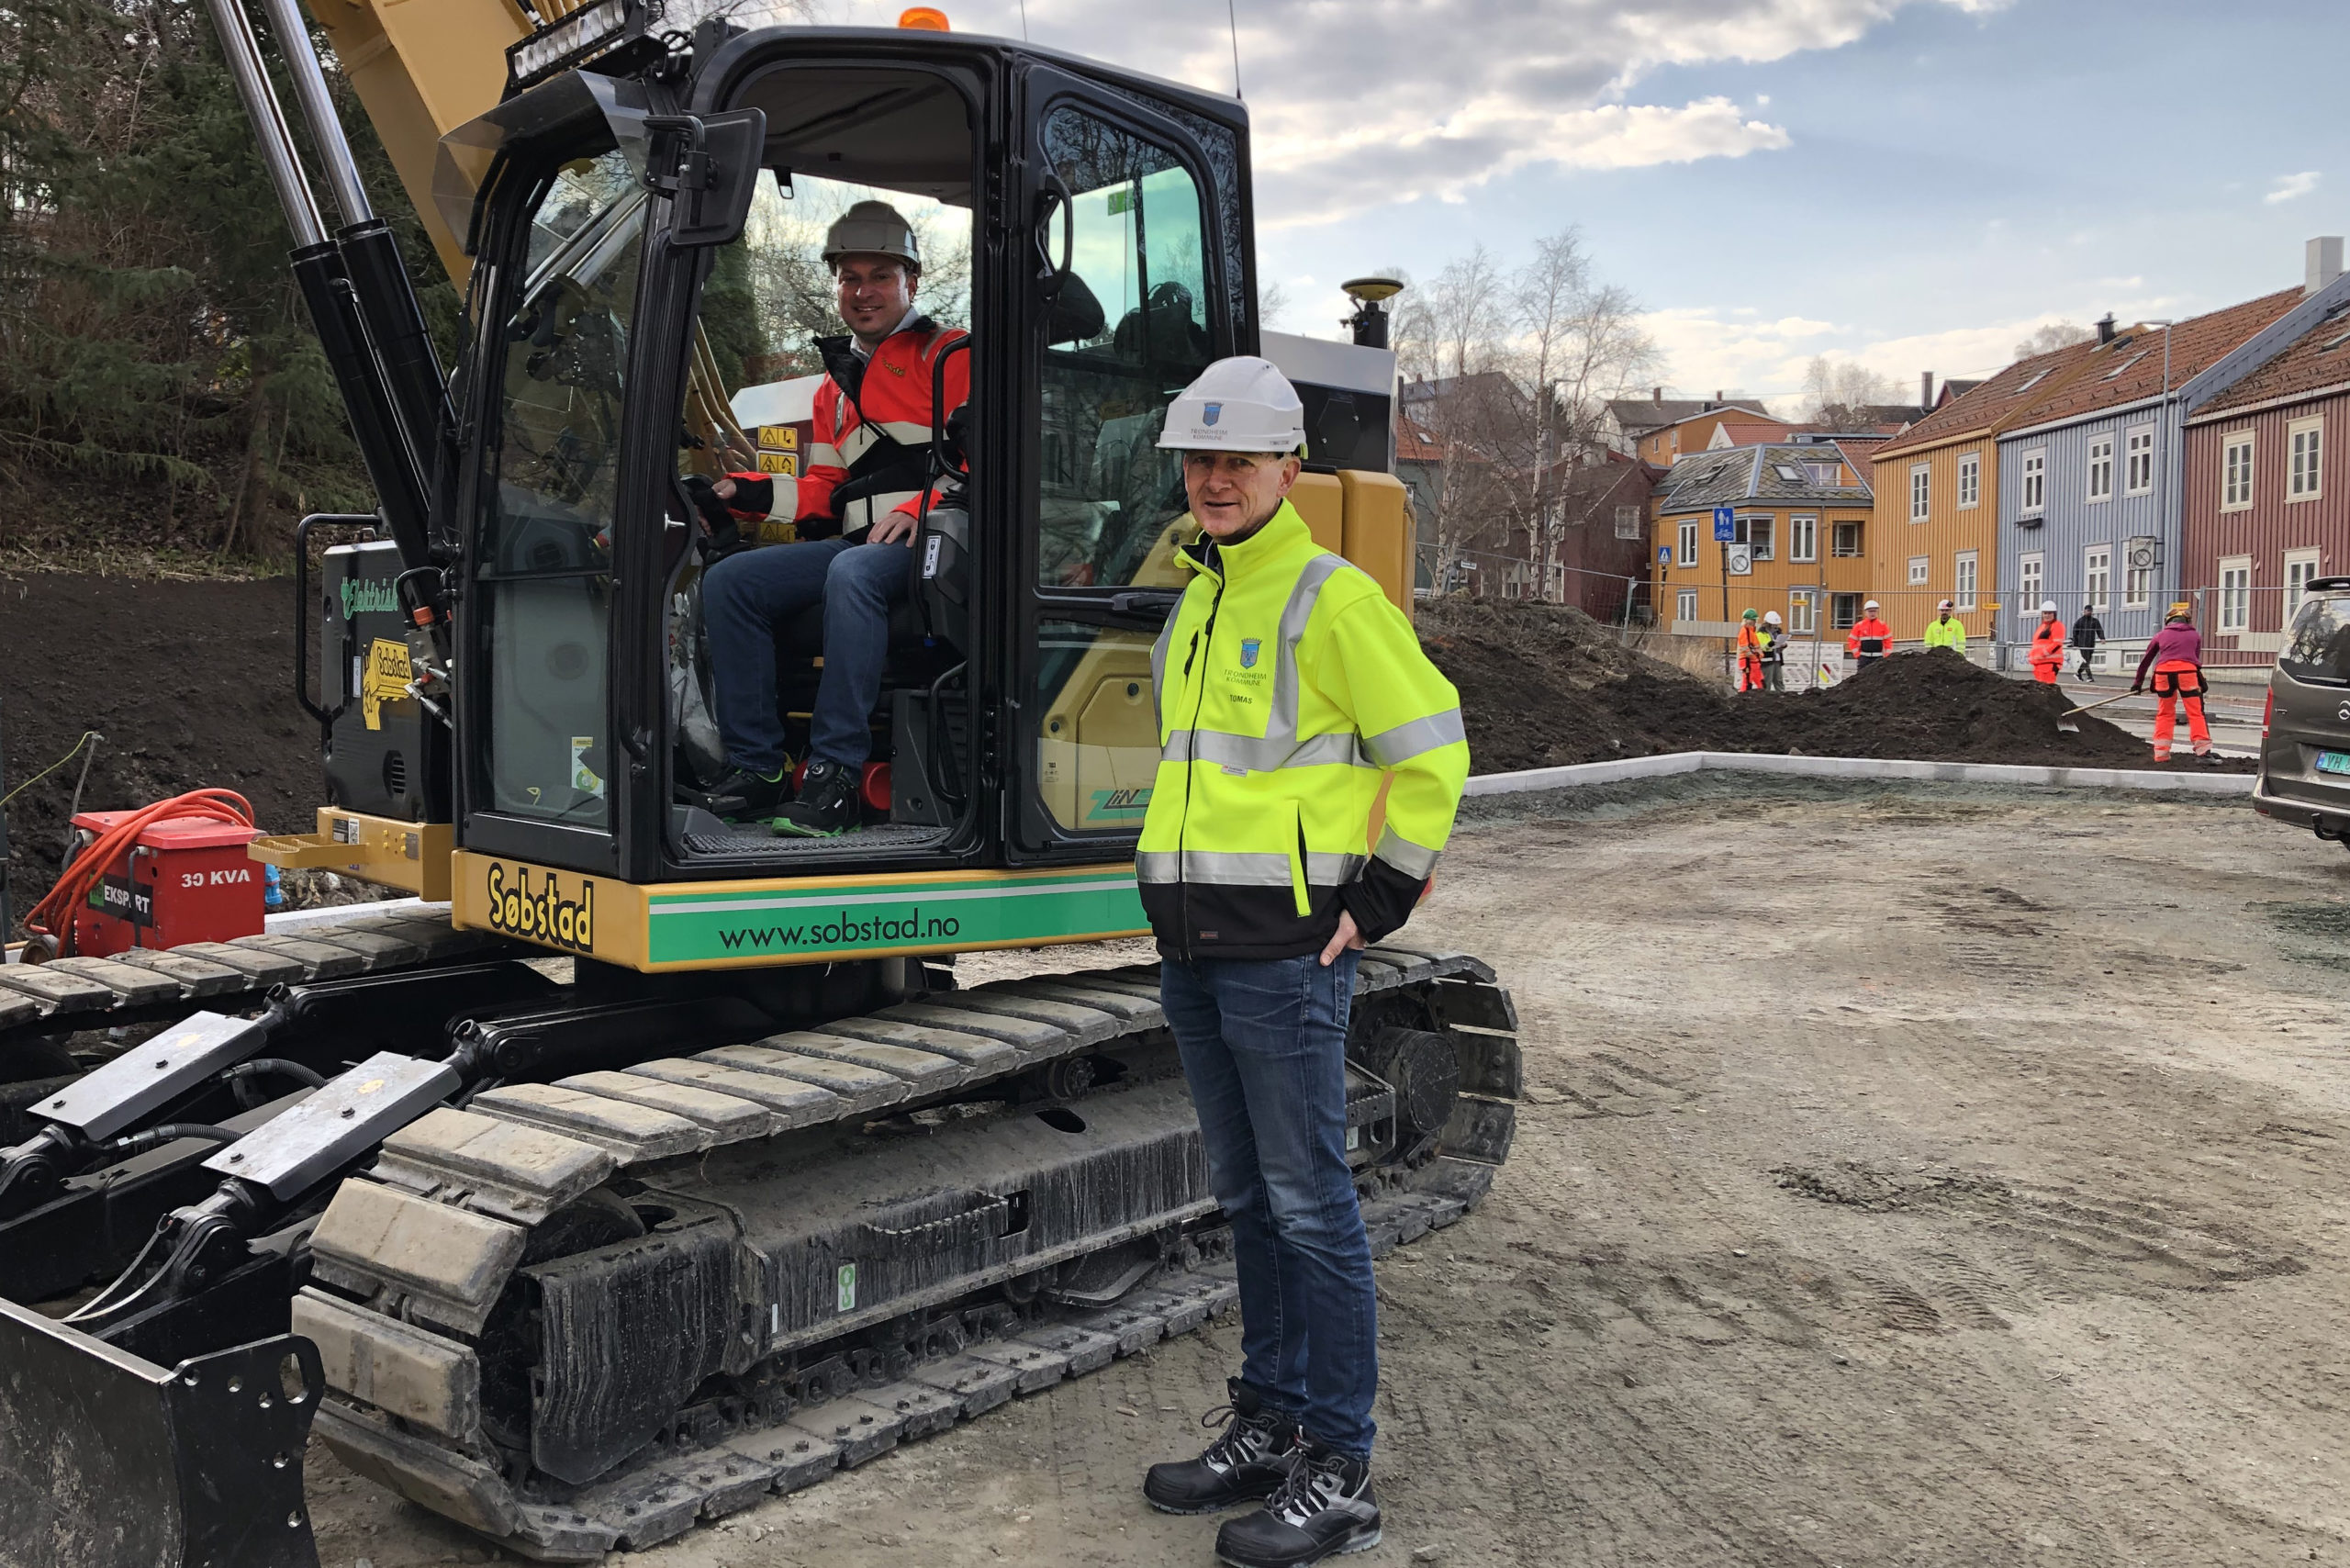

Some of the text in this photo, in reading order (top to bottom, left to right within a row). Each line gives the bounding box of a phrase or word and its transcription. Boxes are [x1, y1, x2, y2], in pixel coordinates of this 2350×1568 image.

[1224, 669, 1267, 680] TRONDHEIM
[1226, 677, 1261, 687] KOMMUNE
[1229, 694, 1253, 704] TOMAS
[181, 868, 250, 888] 30 KVA
[104, 884, 150, 913] EKSPRT
[488, 862, 594, 953] Søbstad
[719, 909, 959, 949] www.sobstad.no
